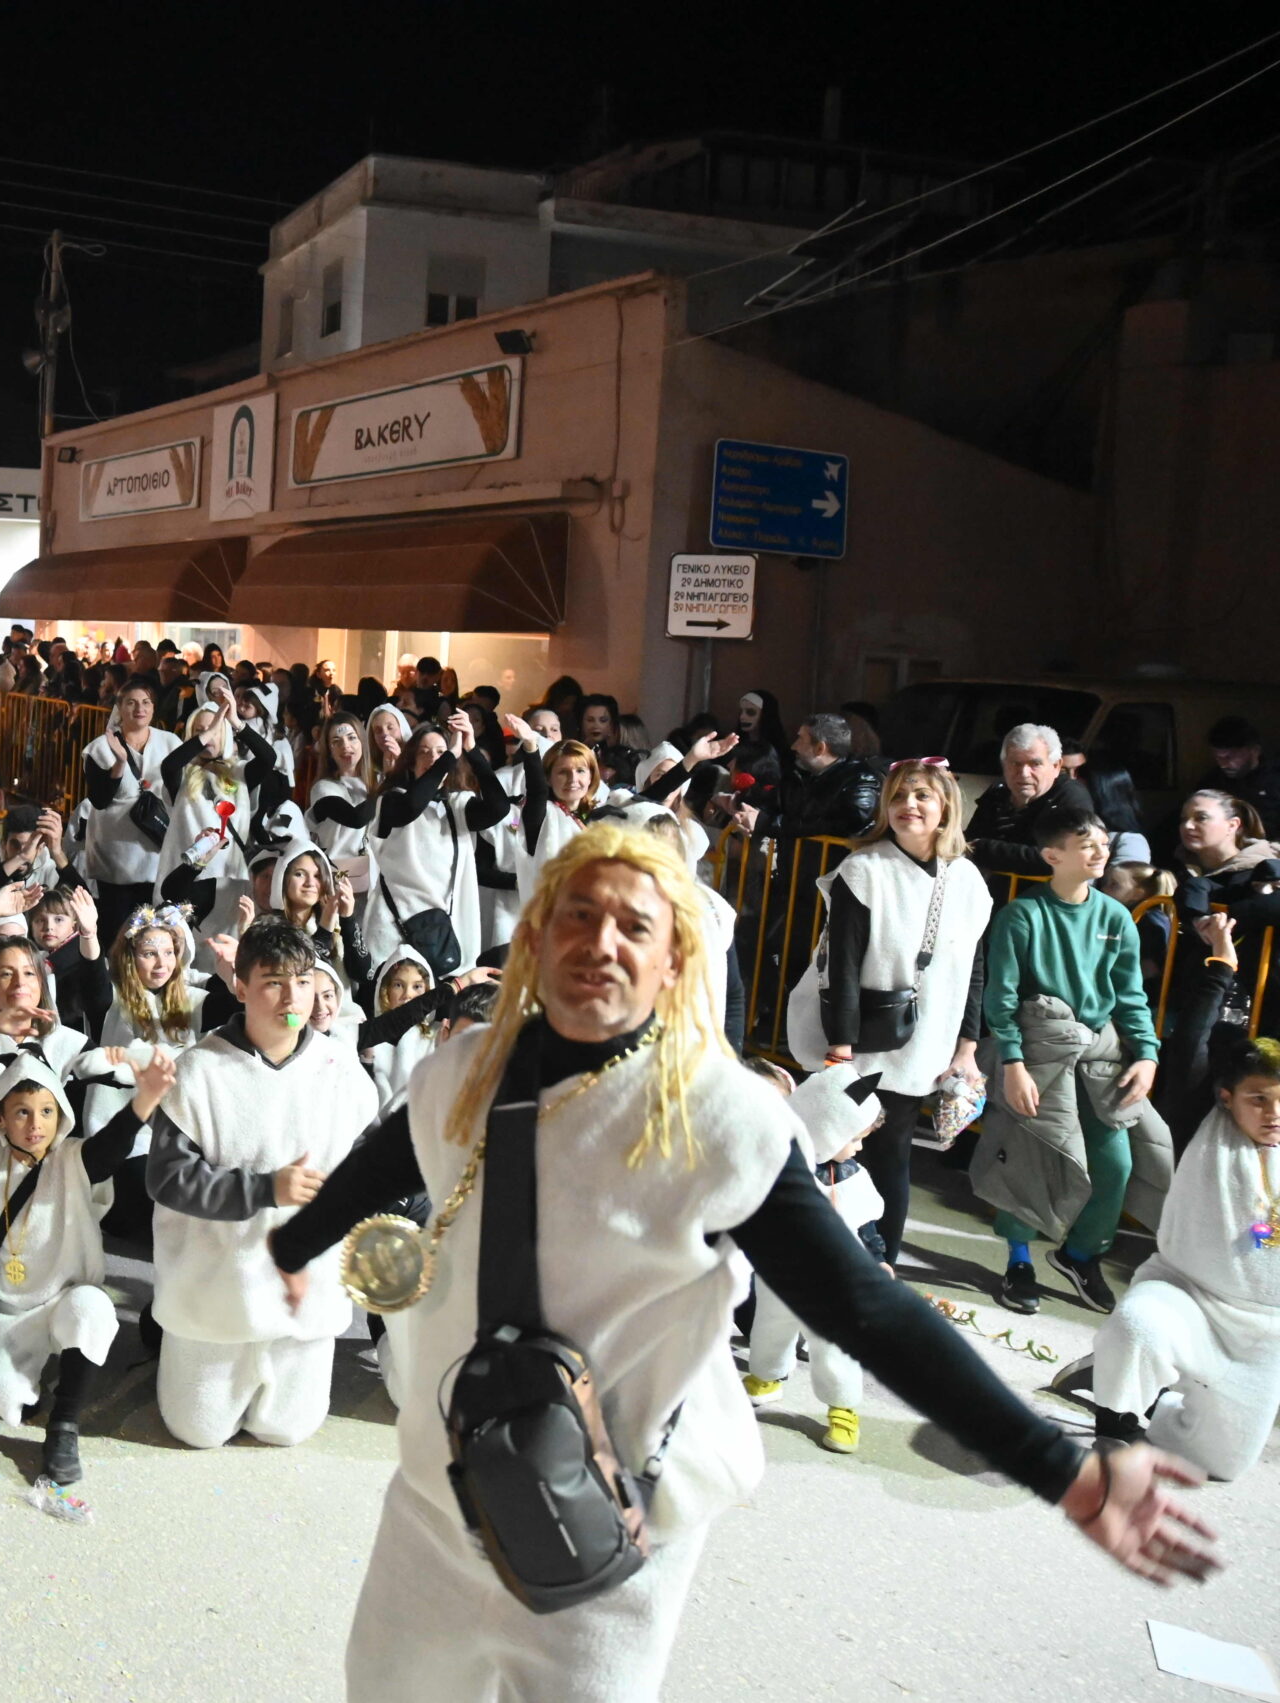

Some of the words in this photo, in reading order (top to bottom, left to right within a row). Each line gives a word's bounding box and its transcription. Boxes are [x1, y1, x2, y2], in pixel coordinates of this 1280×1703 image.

[355, 411, 431, 451] BAKERY
[106, 469, 170, 496] ΑΡΤΟΠΟΙΕΙΟ
[677, 563, 710, 574] ΓΕΝΙΚΟ
[713, 564, 750, 575] ΛΥΚΕΙΟ
[693, 578, 744, 588] ΔΗΜΟΤΙΚΟ
[686, 592, 749, 603] ΝΗΠΙΑΓΩΓΕΙΟ
[685, 603, 748, 614] ΝΗΠΙΑΓΩΓΕΙΟ
